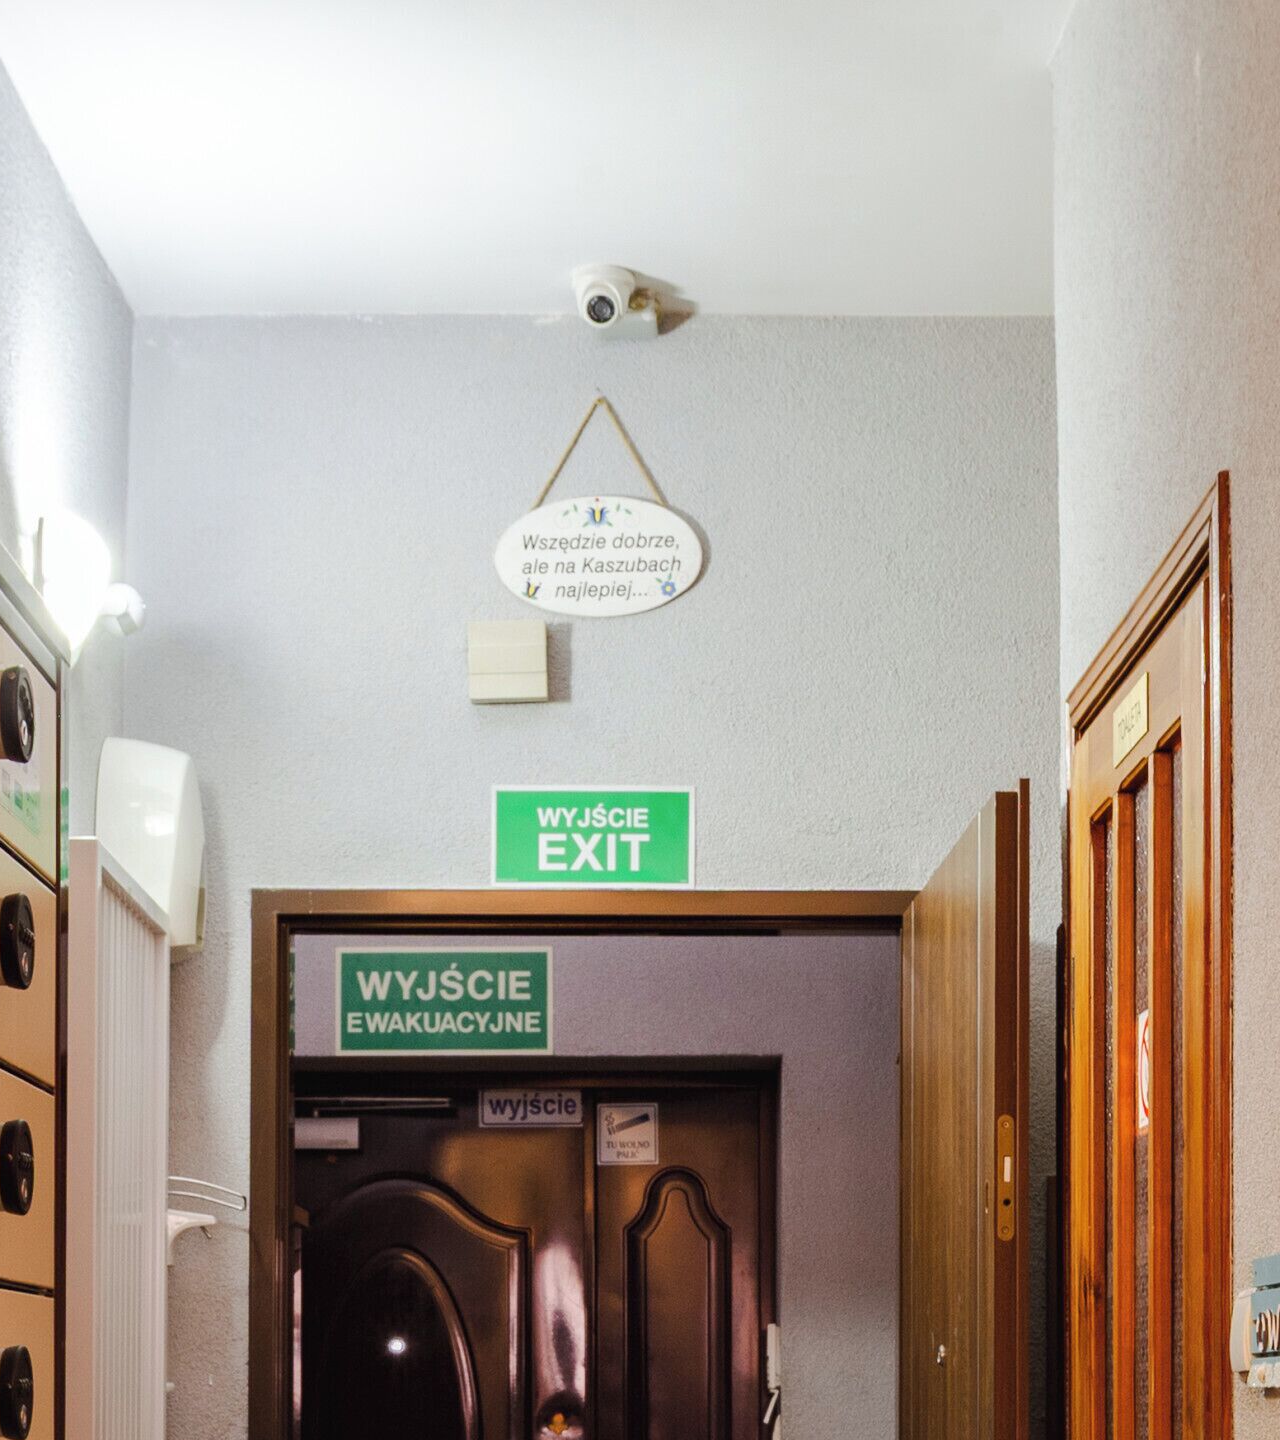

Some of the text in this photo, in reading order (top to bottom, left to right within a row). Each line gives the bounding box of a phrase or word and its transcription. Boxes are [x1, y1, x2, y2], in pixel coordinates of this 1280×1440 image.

[522, 531, 680, 554] Wszędzie dobrze,
[522, 556, 682, 575] ale na Kaszubach
[555, 581, 648, 602] najlepiej...
[536, 802, 650, 828] WYJŚCIE
[537, 832, 651, 872] EXIT
[356, 963, 531, 1002] WYJŚCIE
[347, 1011, 541, 1034] EWAKUACYJNE
[488, 1092, 577, 1121] wyjście
[619, 1140, 650, 1150] WOLNO
